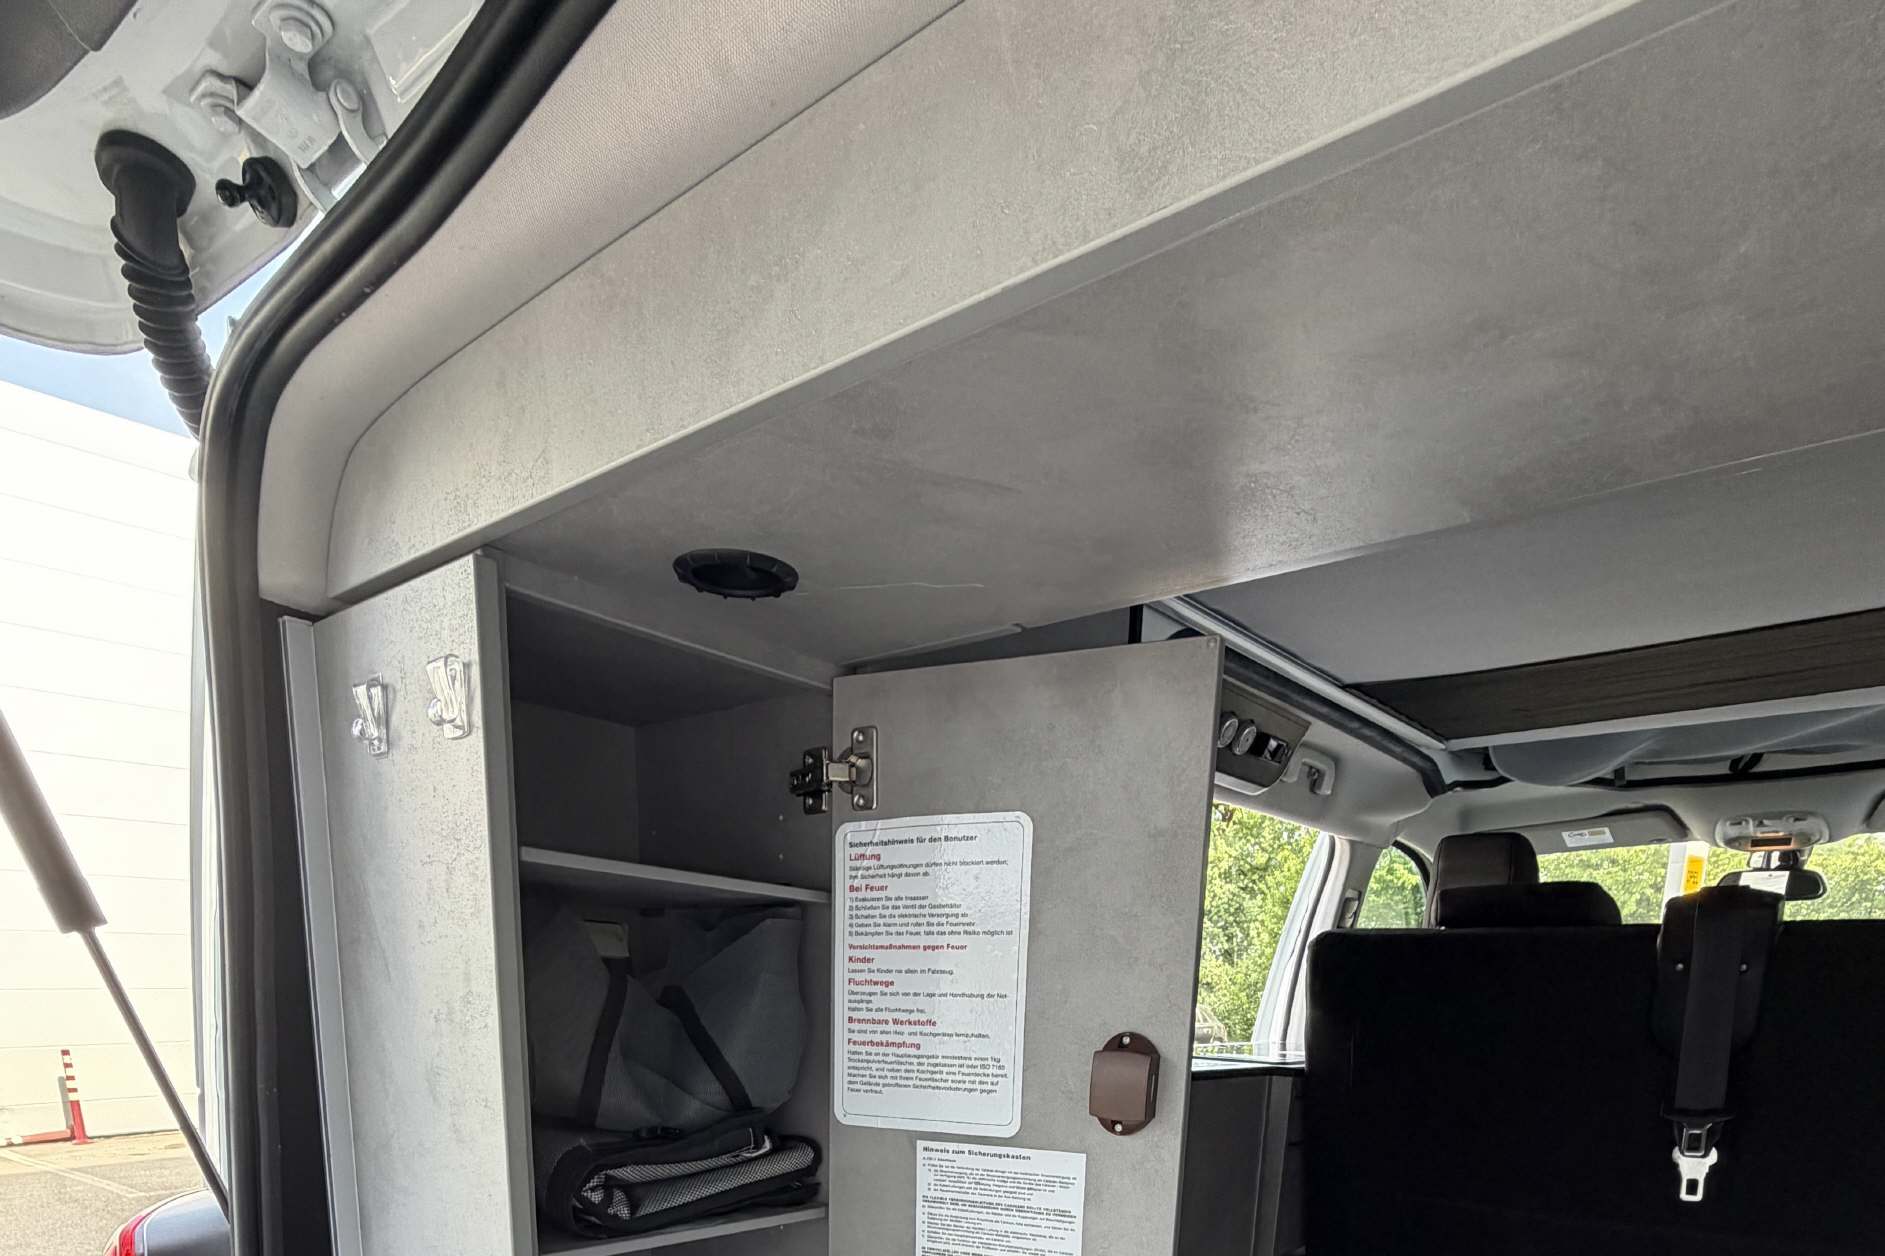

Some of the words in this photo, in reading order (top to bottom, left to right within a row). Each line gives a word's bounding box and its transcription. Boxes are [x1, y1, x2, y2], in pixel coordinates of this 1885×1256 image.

[916, 836, 926, 844] für
[849, 852, 880, 862] Lüftung
[848, 884, 862, 892] Bei
[865, 884, 888, 892] Feuer
[848, 956, 875, 964] Kinder
[848, 978, 895, 988] Fluchtwege
[848, 1016, 890, 1025] Brennbare
[892, 1018, 937, 1027] Werkstoffe
[848, 1038, 921, 1050] Feuerbekämpfung
[922, 1146, 950, 1154] Hinweis
[968, 1150, 1031, 1160] Sicherungskasten
